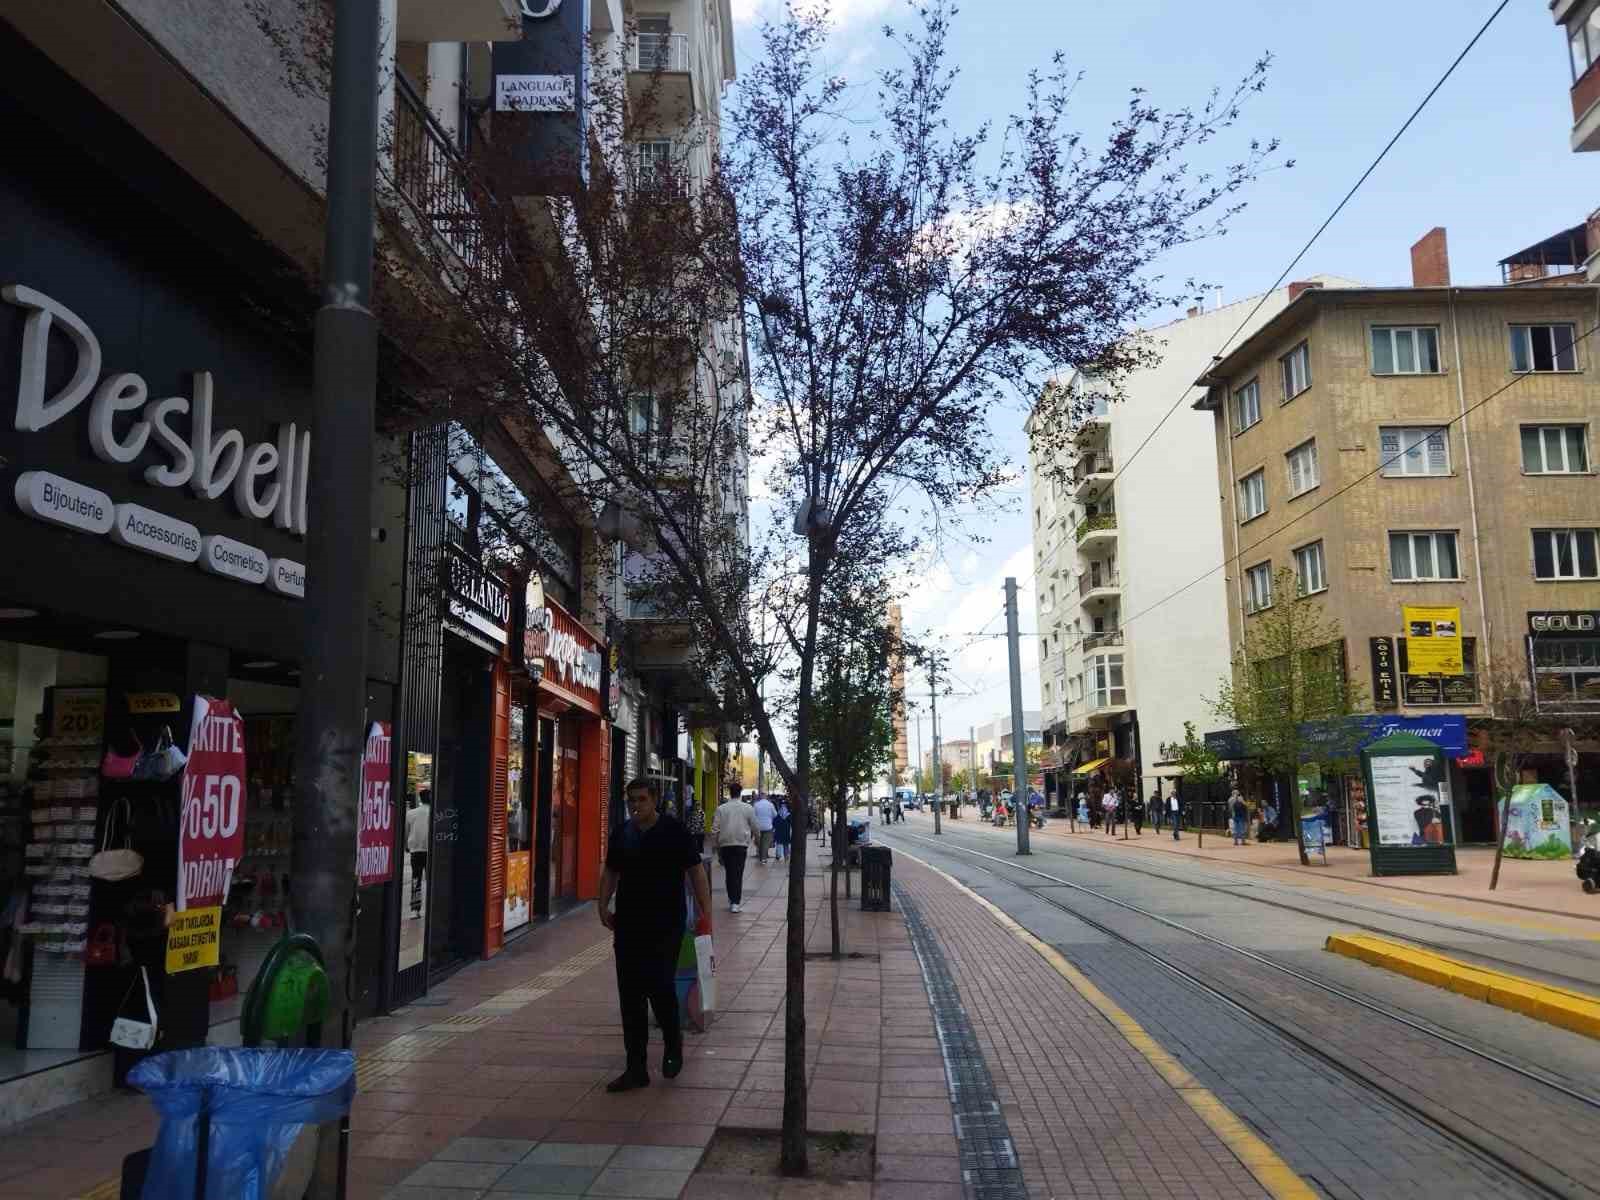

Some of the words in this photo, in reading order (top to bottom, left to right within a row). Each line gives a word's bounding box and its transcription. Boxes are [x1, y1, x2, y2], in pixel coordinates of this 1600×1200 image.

[1, 284, 310, 534] Desbell
[43, 482, 103, 521] Bijouterie
[126, 513, 199, 553] Accessories
[213, 543, 265, 575] Cosmetics
[1531, 614, 1595, 631] GOLD
[181, 773, 241, 840] %50
[359, 780, 390, 831] %50
